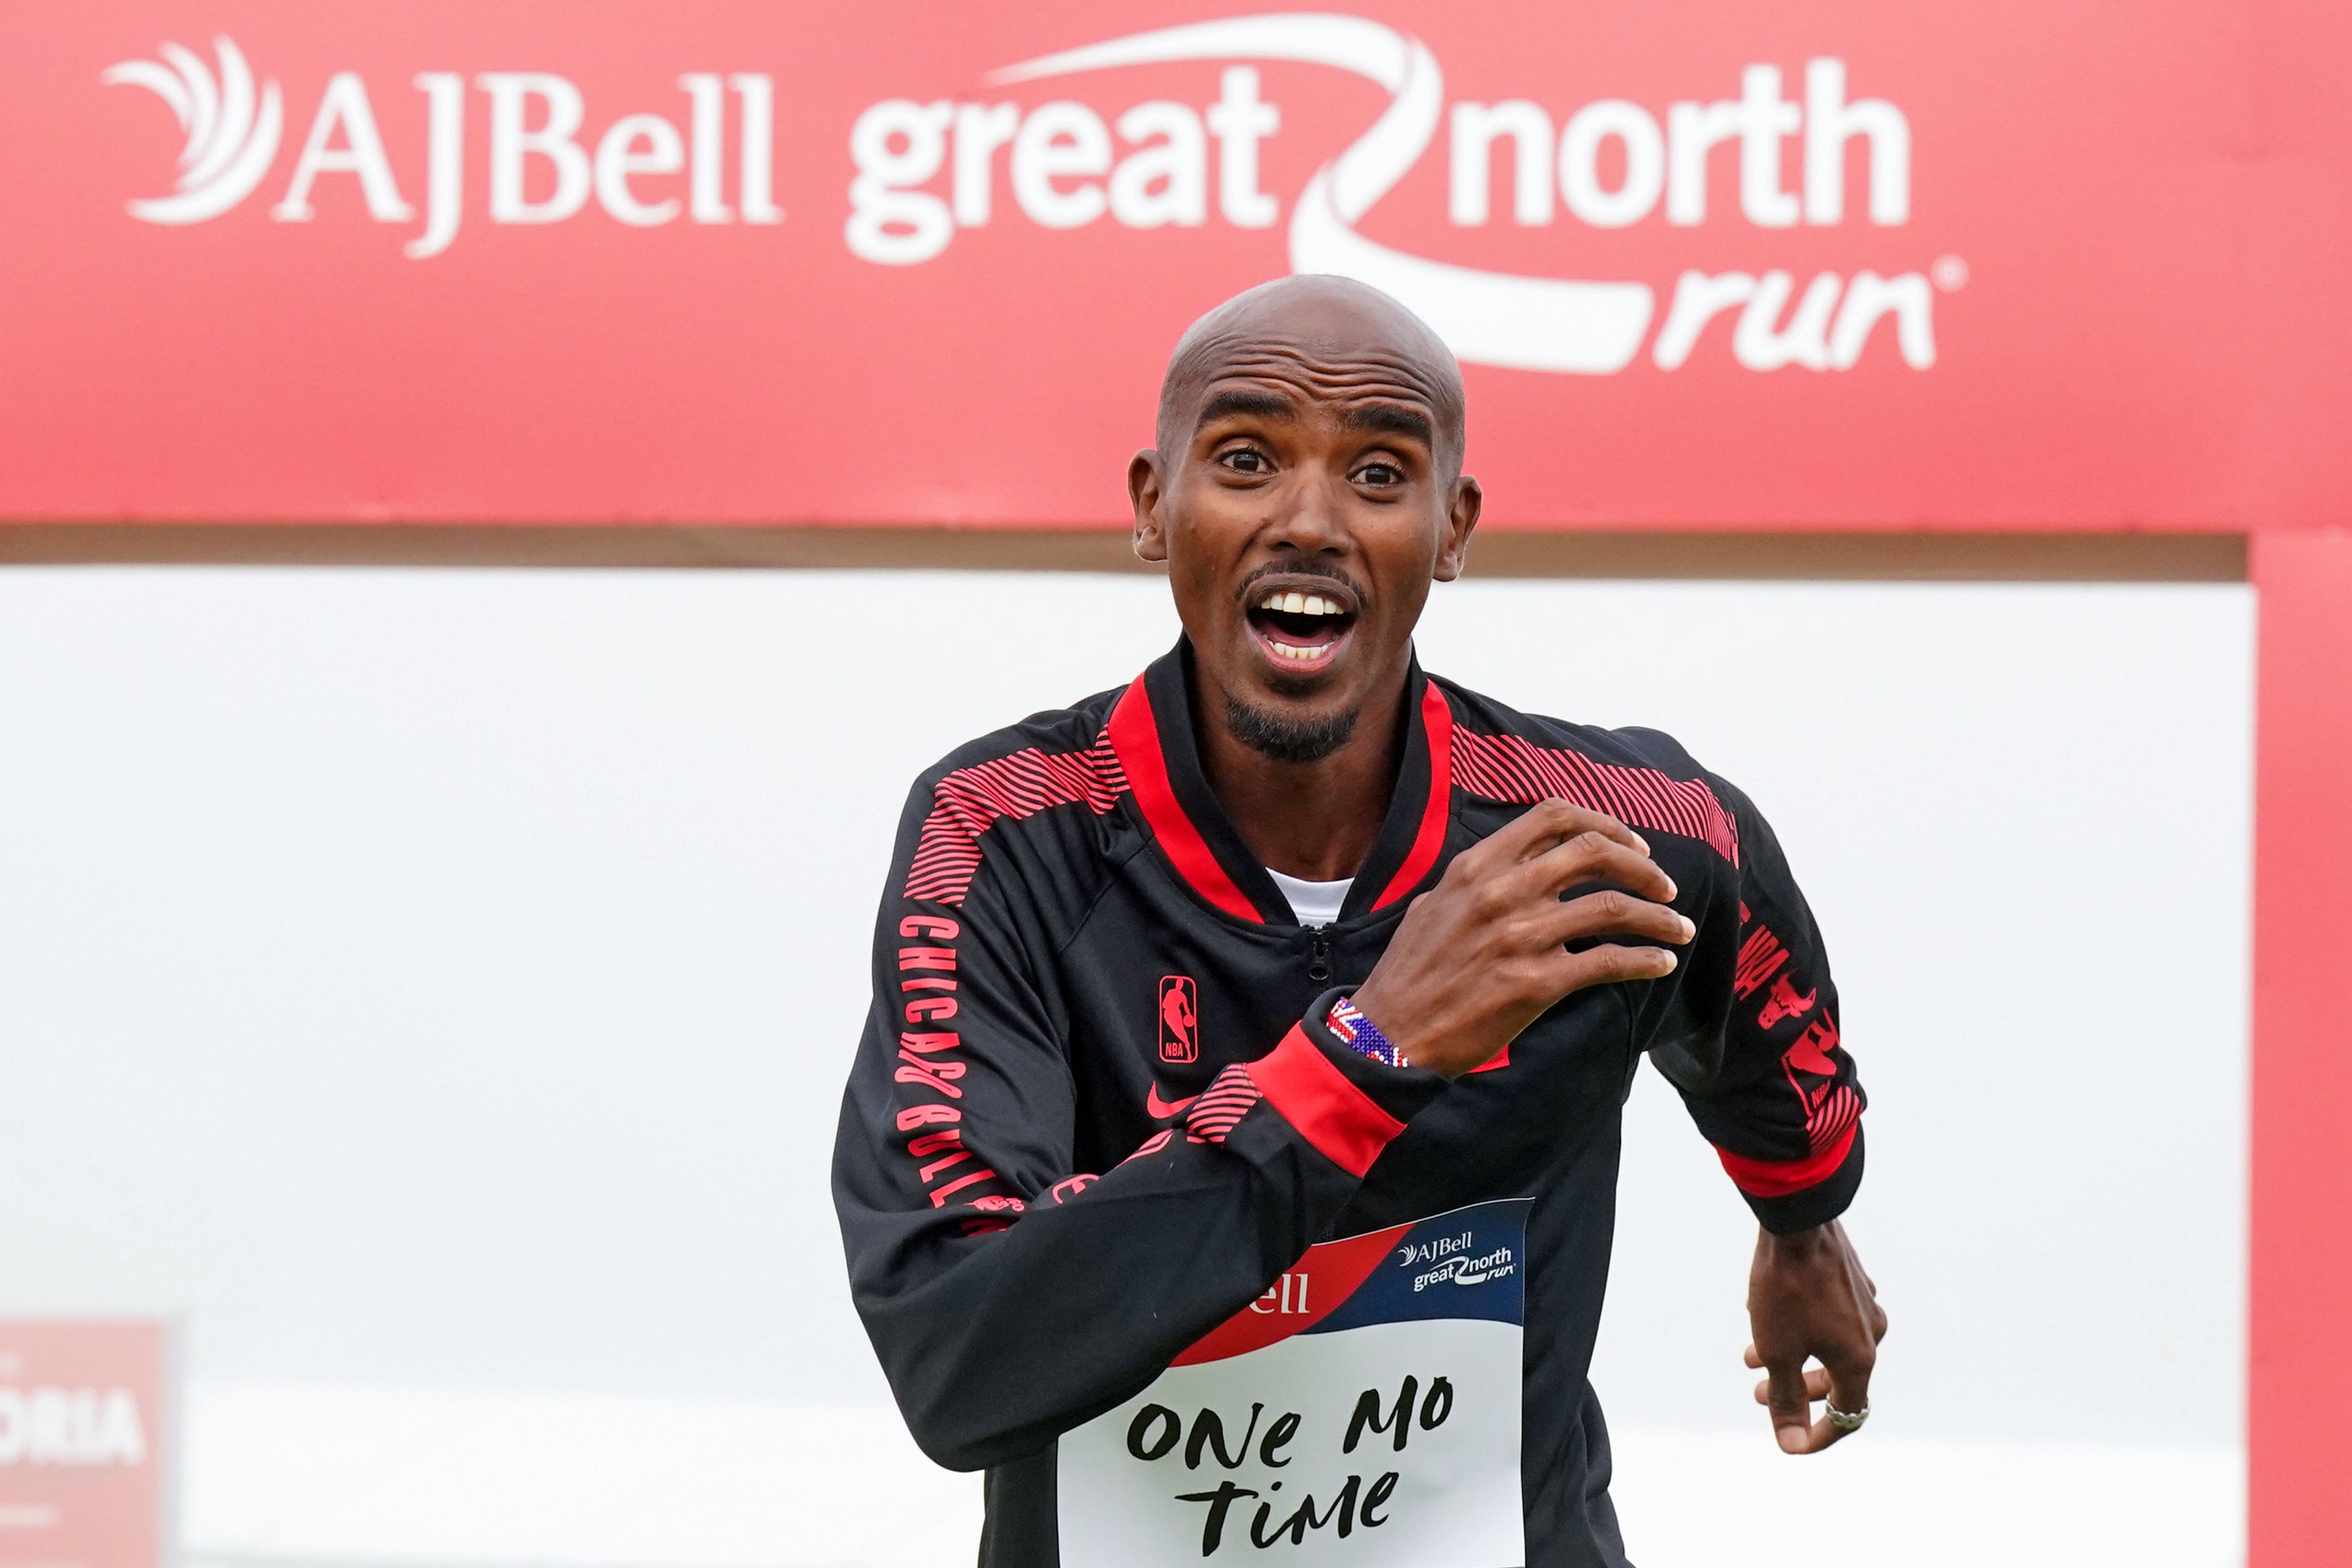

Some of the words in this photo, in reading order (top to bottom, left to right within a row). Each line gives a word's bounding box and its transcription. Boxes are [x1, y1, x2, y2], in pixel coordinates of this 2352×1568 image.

[270, 70, 786, 259] AJBell
[844, 65, 1281, 266] great
[1448, 56, 1912, 229] north
[894, 915, 967, 1099] CHICAGO
[1165, 1042, 1184, 1058] NBA
[1414, 1263, 1454, 1292] great
[1469, 1247, 1512, 1272] north
[1416, 1230, 1472, 1263] AJBell
[1249, 1273, 1310, 1314] ell
[0, 1387, 145, 1463] ORIA
